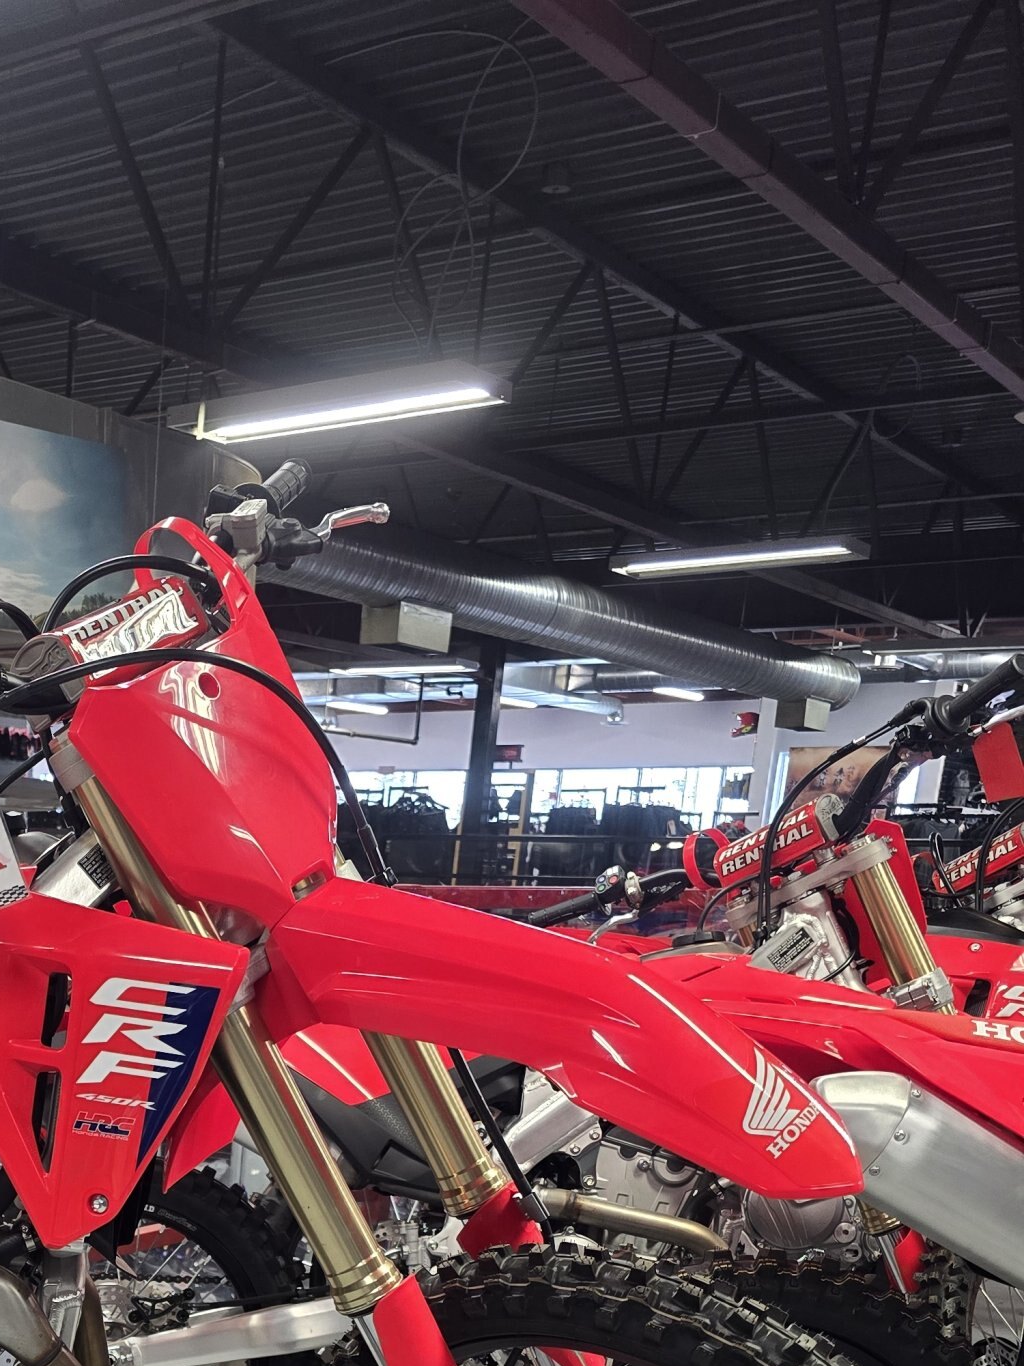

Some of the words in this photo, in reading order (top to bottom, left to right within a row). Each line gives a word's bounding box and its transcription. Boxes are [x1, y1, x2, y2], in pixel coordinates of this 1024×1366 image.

[75, 976, 198, 1084] CRF
[76, 1093, 158, 1111] 450R
[73, 1110, 137, 1137] HRC
